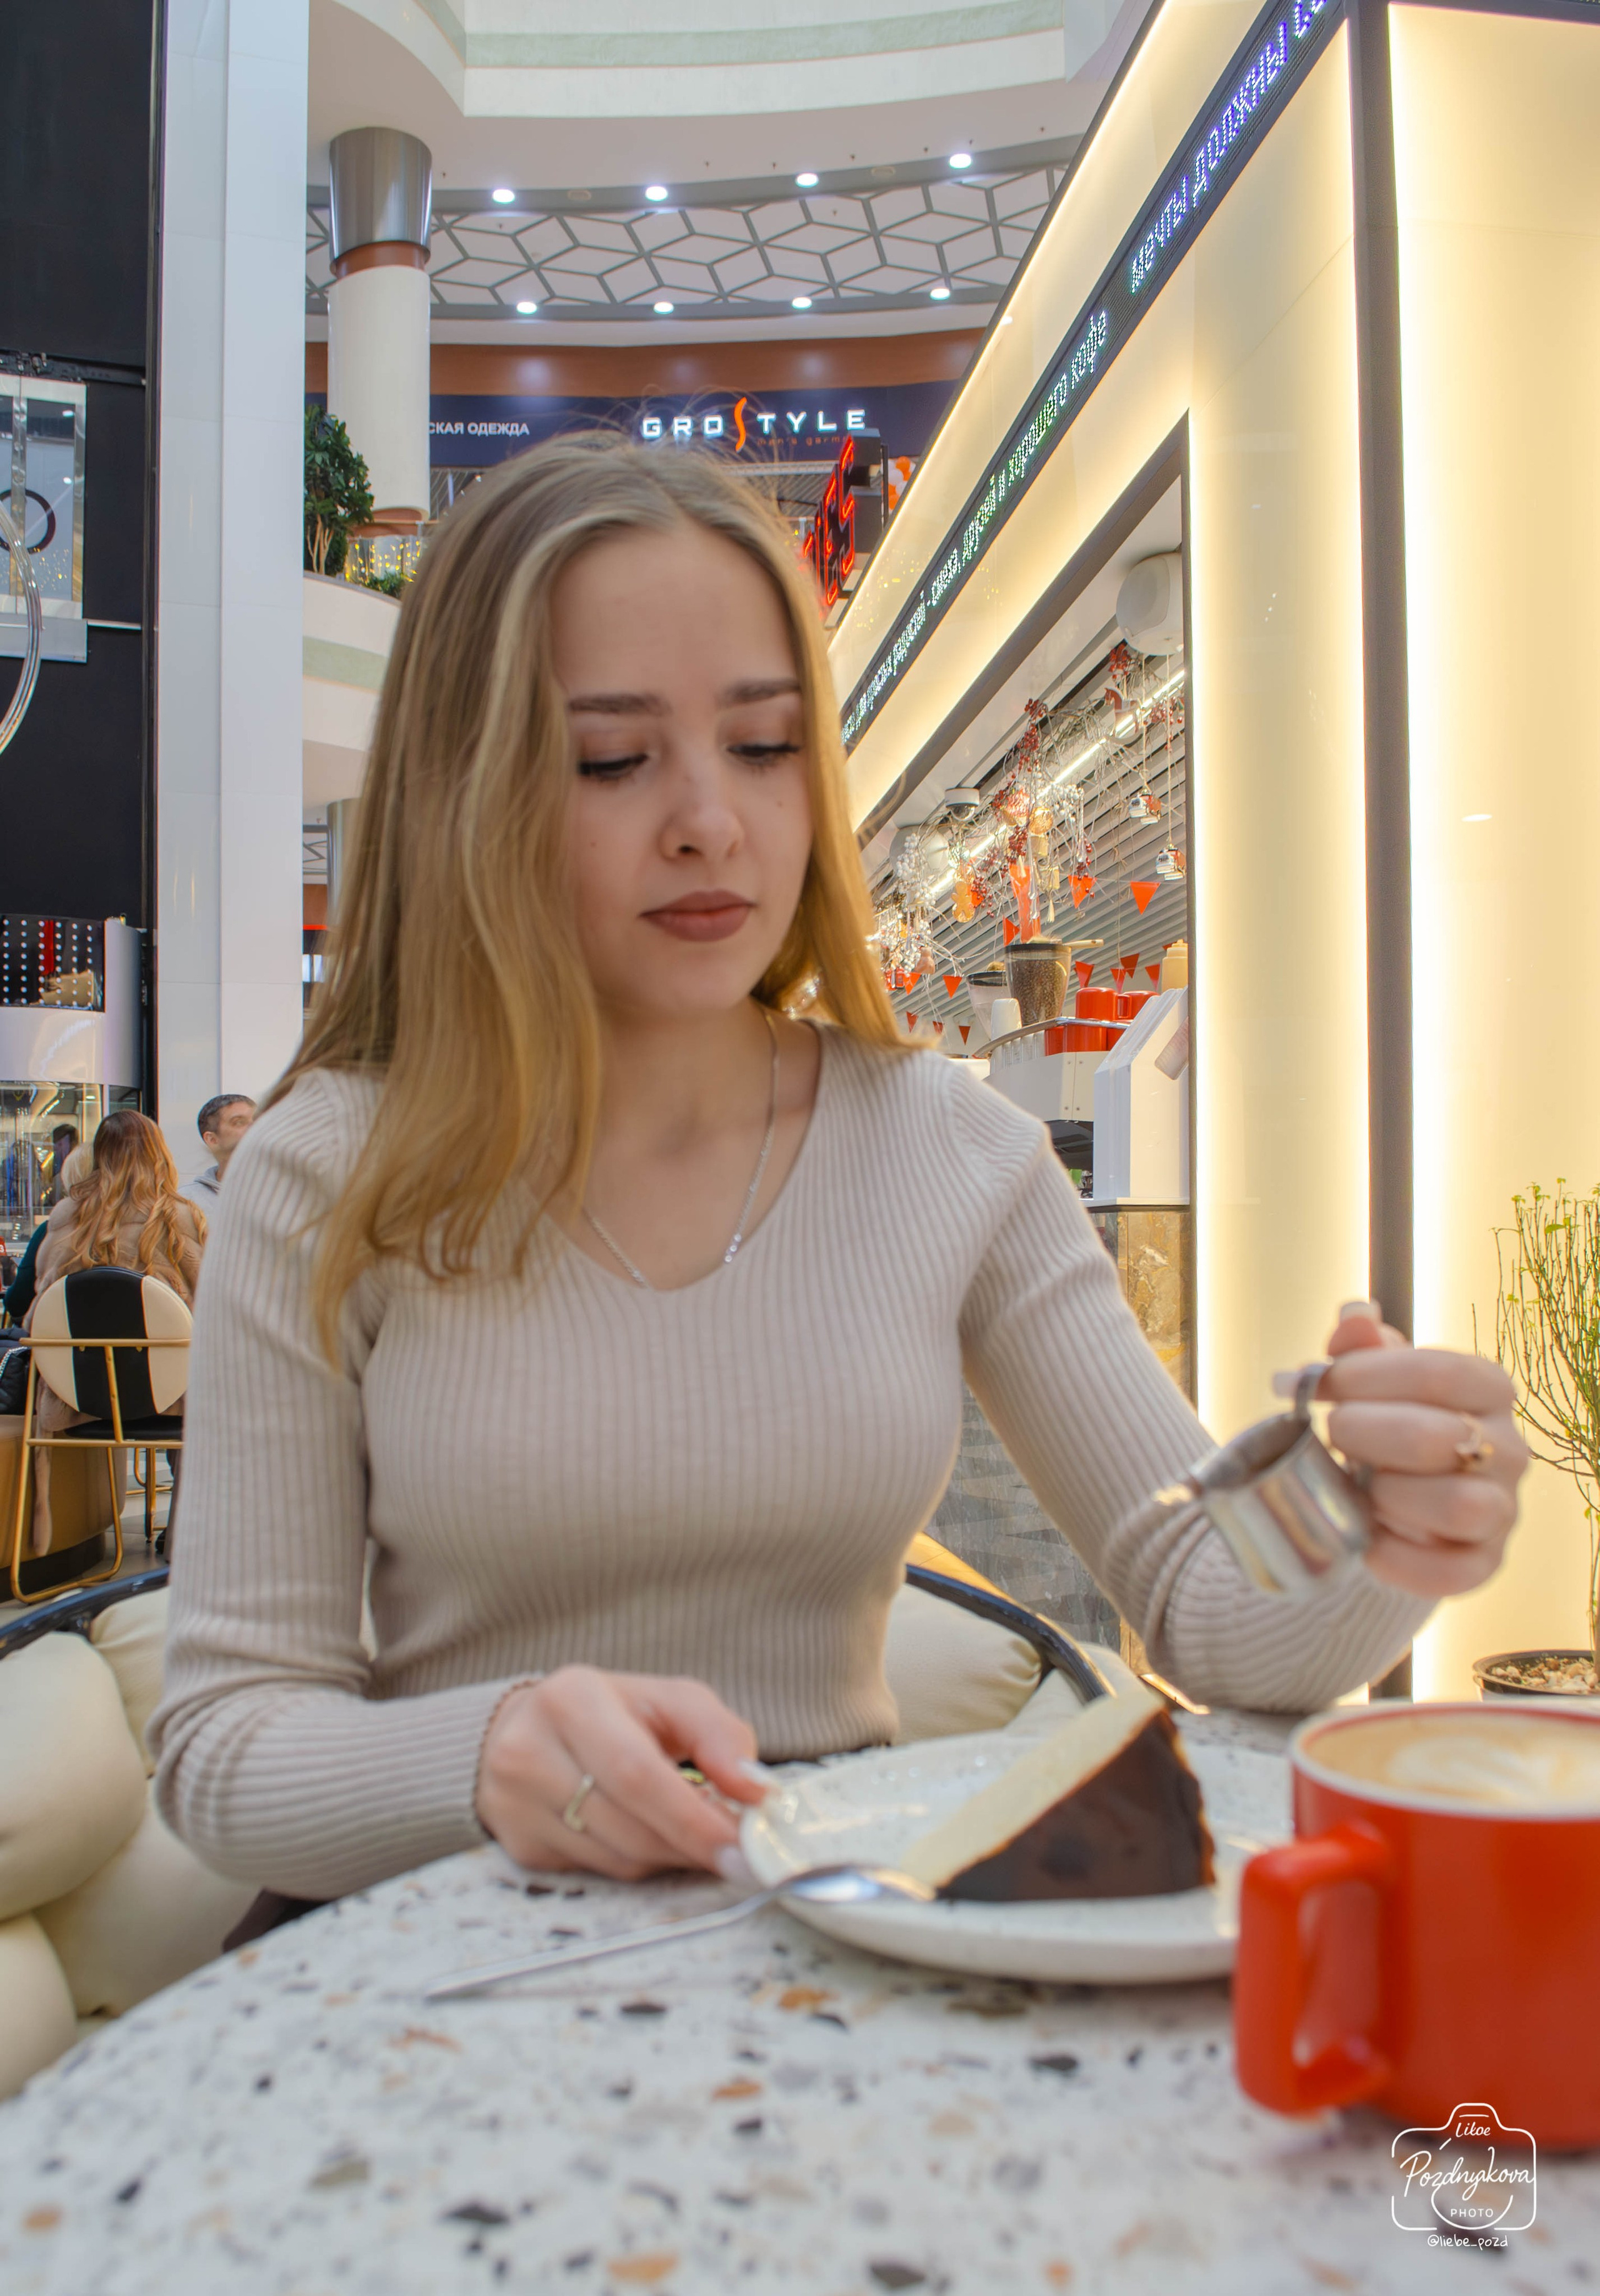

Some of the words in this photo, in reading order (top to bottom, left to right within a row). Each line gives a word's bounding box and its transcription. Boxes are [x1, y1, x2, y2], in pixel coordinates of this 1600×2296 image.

[468, 422, 530, 437] ОДЕЖДА
[642, 396, 866, 453] GROSTYLE
[892, 589, 926, 676] радостей
[962, 473, 995, 566] друзей
[999, 469, 1005, 502] и
[1008, 373, 1067, 487] хорошего
[1071, 311, 1106, 389] кофе
